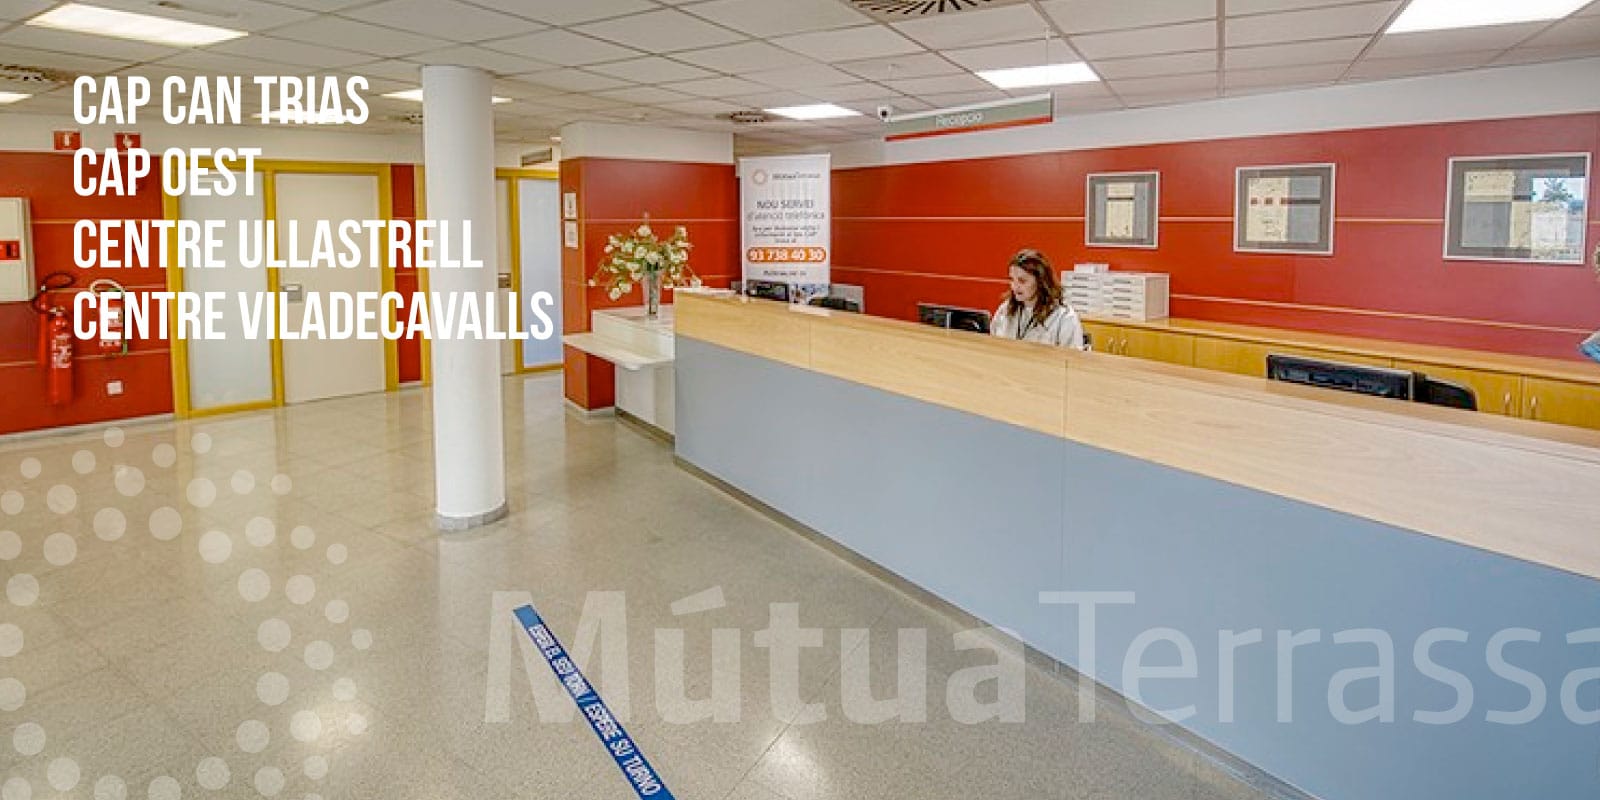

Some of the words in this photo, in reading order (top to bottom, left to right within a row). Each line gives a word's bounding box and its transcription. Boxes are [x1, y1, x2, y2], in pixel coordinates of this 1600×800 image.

[750, 249, 764, 261] 93
[610, 738, 635, 757] SU
[624, 755, 661, 796] TURNO
